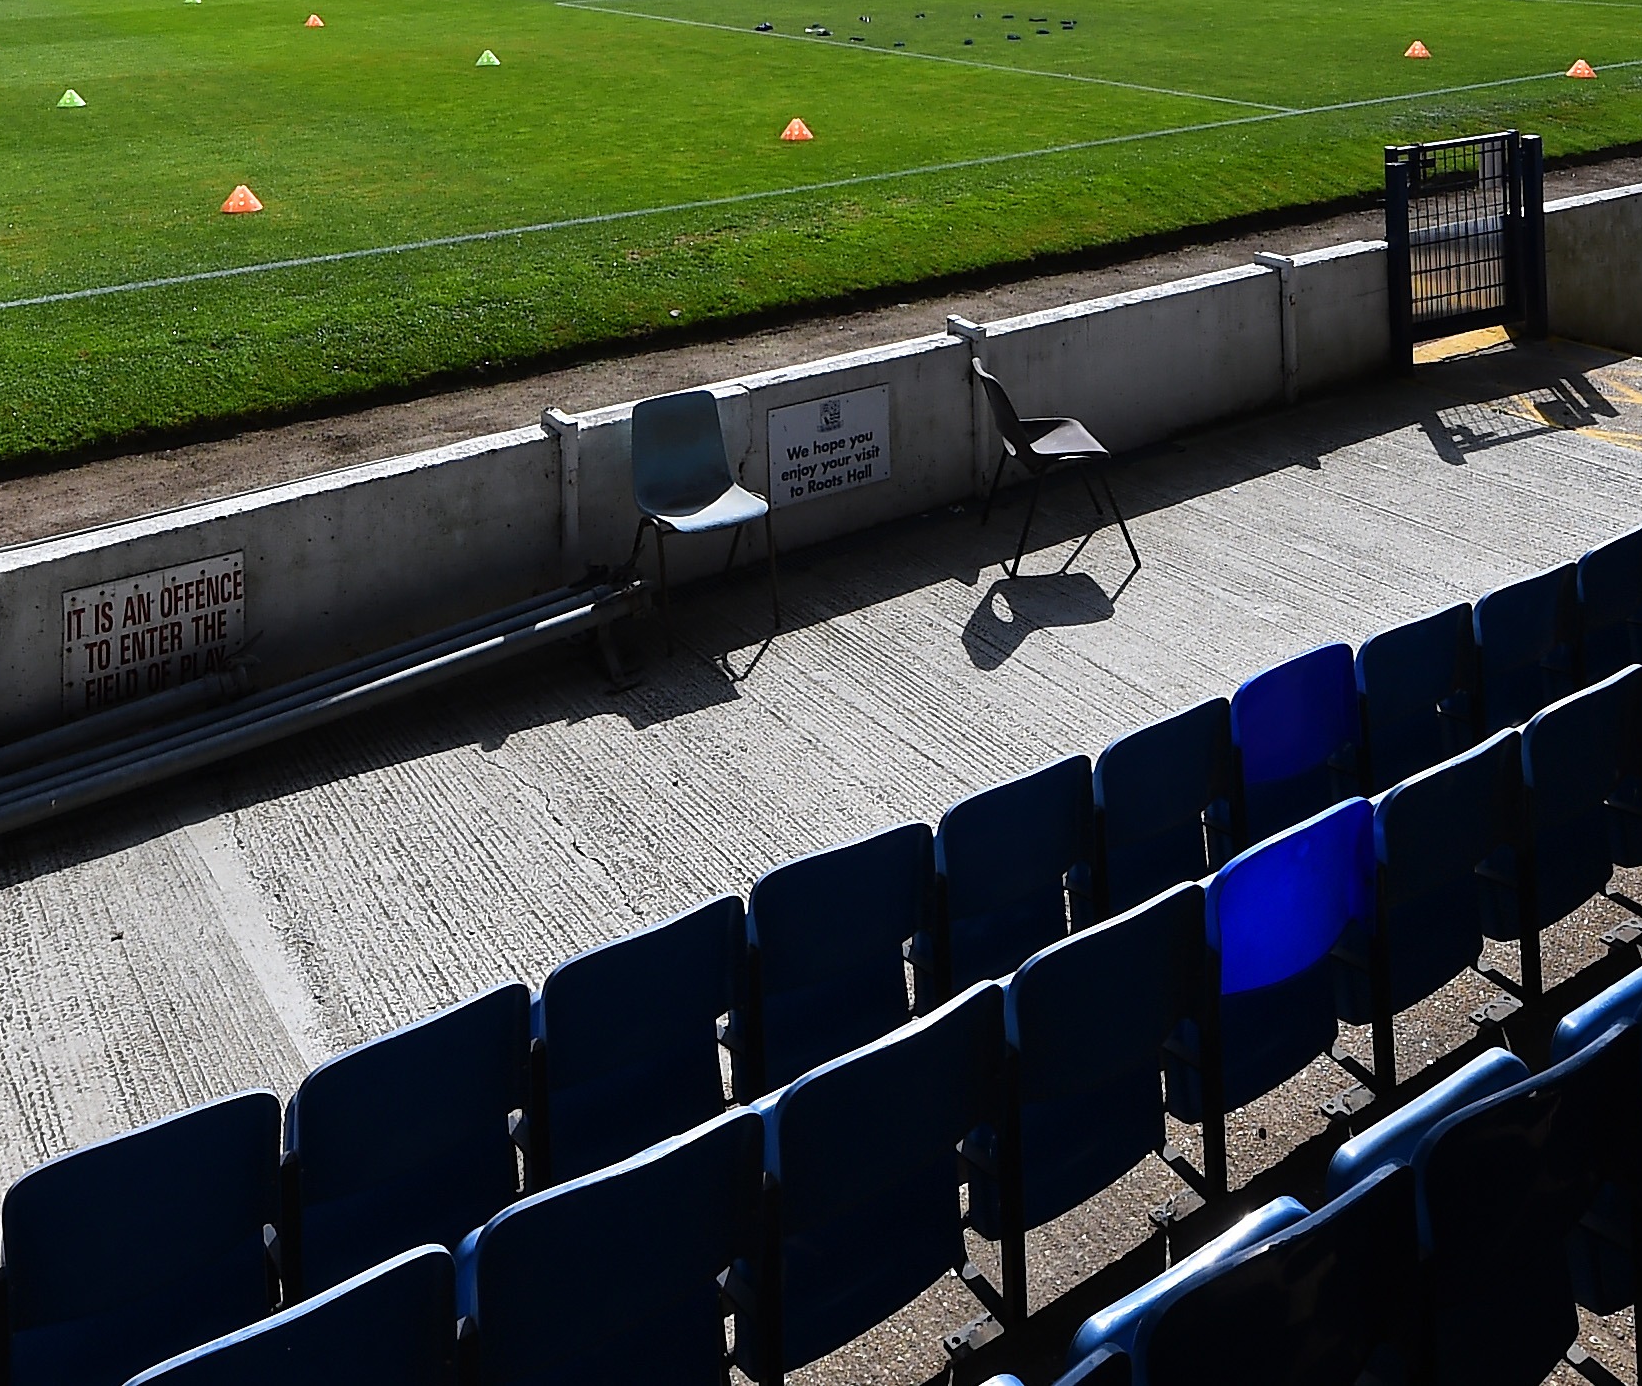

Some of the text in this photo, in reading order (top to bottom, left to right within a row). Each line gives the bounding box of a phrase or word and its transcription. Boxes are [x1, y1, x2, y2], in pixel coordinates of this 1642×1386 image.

[781, 445, 880, 481] enjoy your visit
[786, 431, 874, 461] We hope you
[790, 464, 873, 498] to Roots Hall
[66, 570, 244, 643] IT IS AN OFFENCE
[85, 609, 228, 674] TO ENTER THE
[85, 644, 227, 710] FIELD OF PLAY
